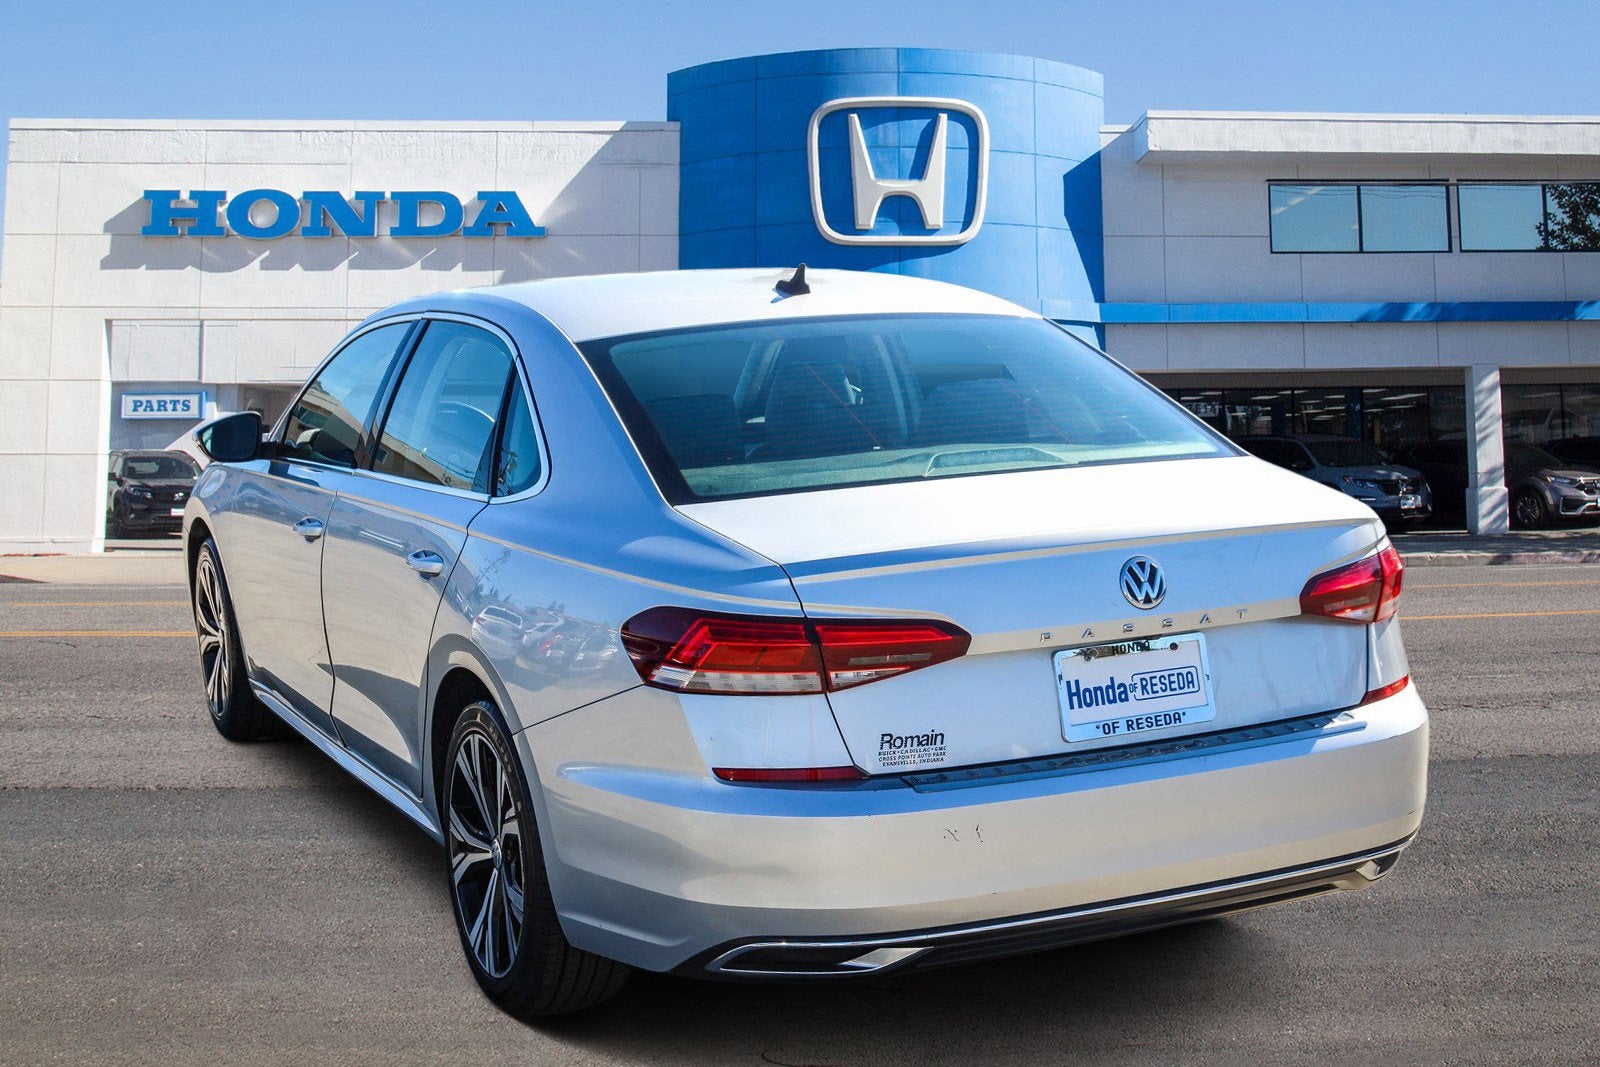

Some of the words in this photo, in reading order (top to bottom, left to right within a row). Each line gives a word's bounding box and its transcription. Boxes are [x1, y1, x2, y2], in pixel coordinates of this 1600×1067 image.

[141, 189, 547, 240] HONDA
[131, 399, 192, 413] PARTS
[1040, 608, 1248, 643] PASSAT
[1066, 676, 1130, 710] Honda
[1129, 682, 1138, 694] OF
[1140, 671, 1196, 696] RESEDA
[879, 729, 945, 750] Romain
[878, 754, 897, 762] CROSS
